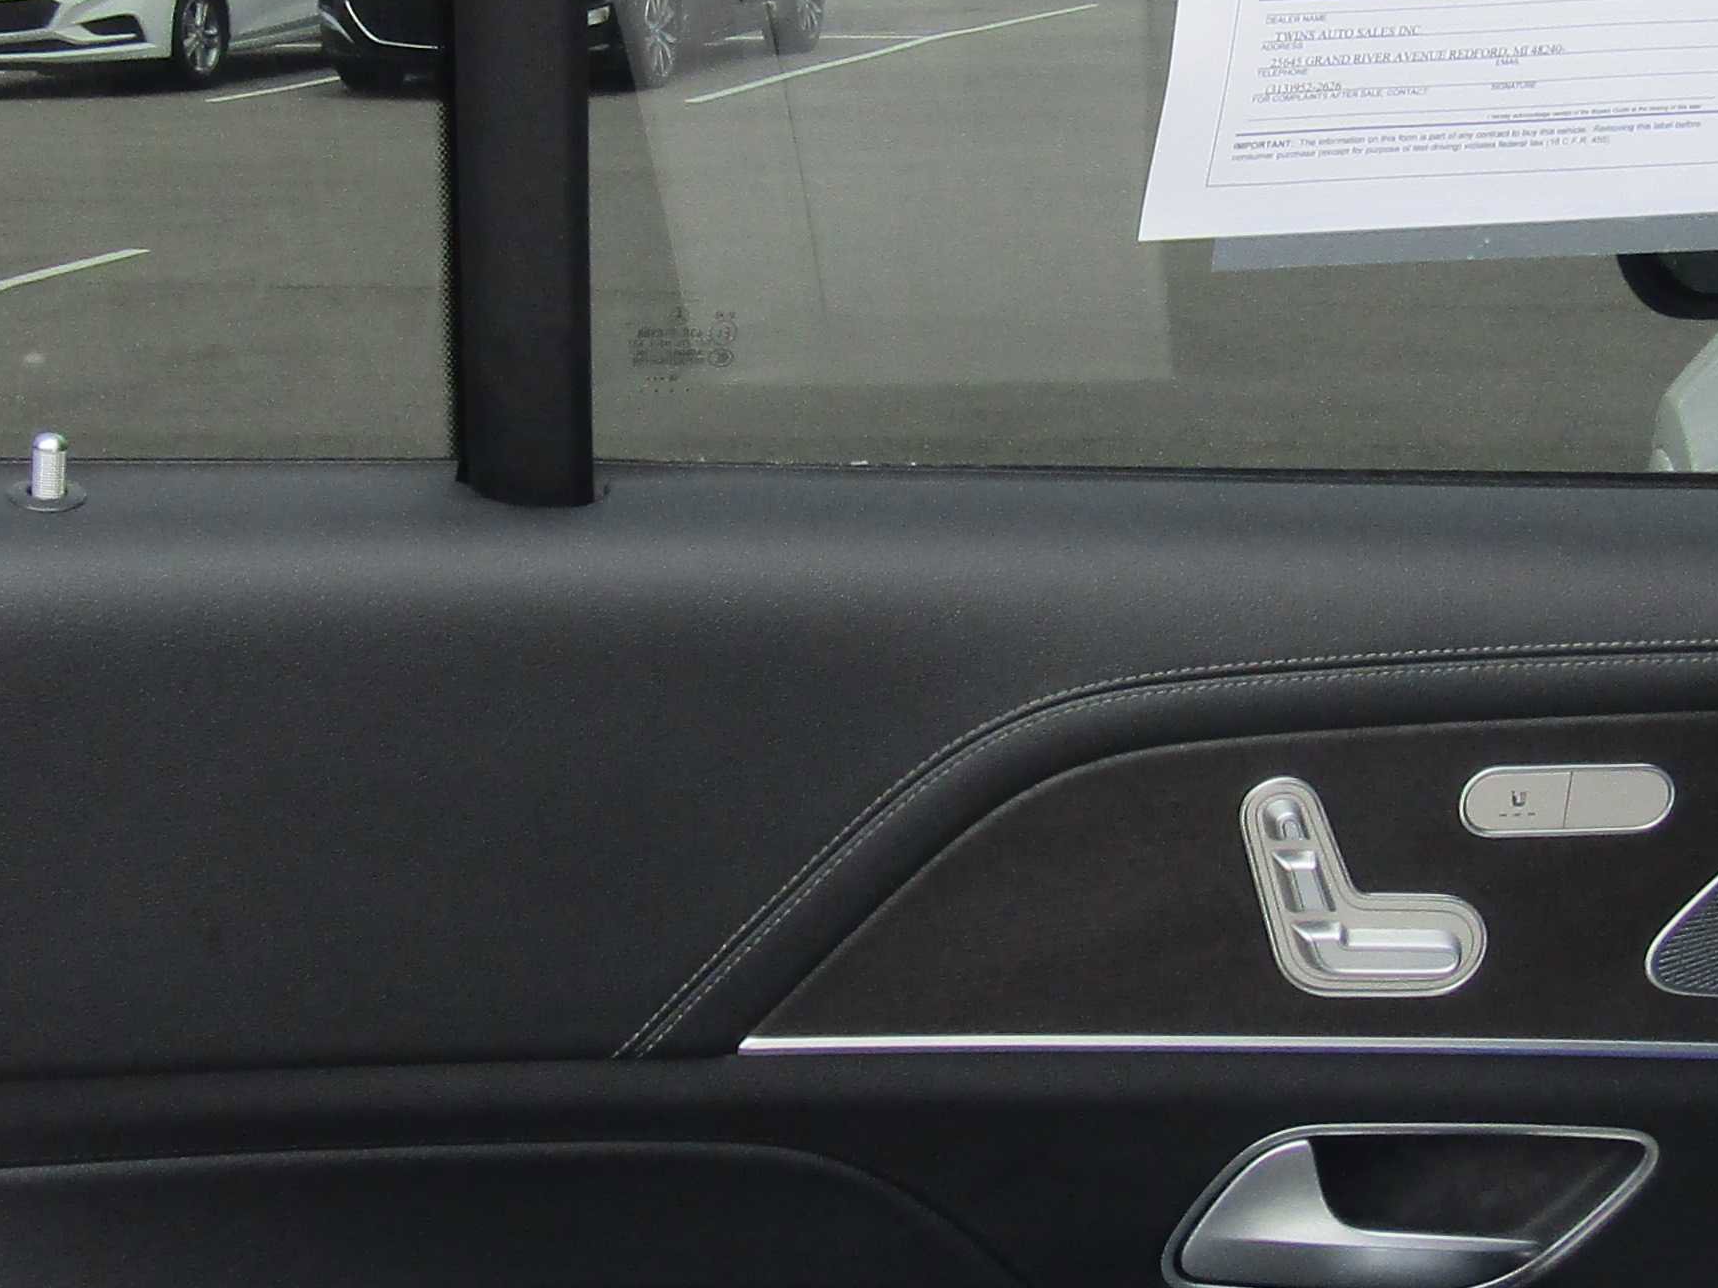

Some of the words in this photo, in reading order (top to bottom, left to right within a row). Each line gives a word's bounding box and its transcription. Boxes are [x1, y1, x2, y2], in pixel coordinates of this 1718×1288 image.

[1275, 31, 1316, 42] TWINS
[1318, 28, 1354, 40] AUTO
[1356, 26, 1395, 38] SALES
[1398, 25, 1421, 36] INC
[1305, 55, 1352, 66] GRAND
[1354, 52, 1391, 64] RIVER
[1394, 50, 1444, 62] AVENUE
